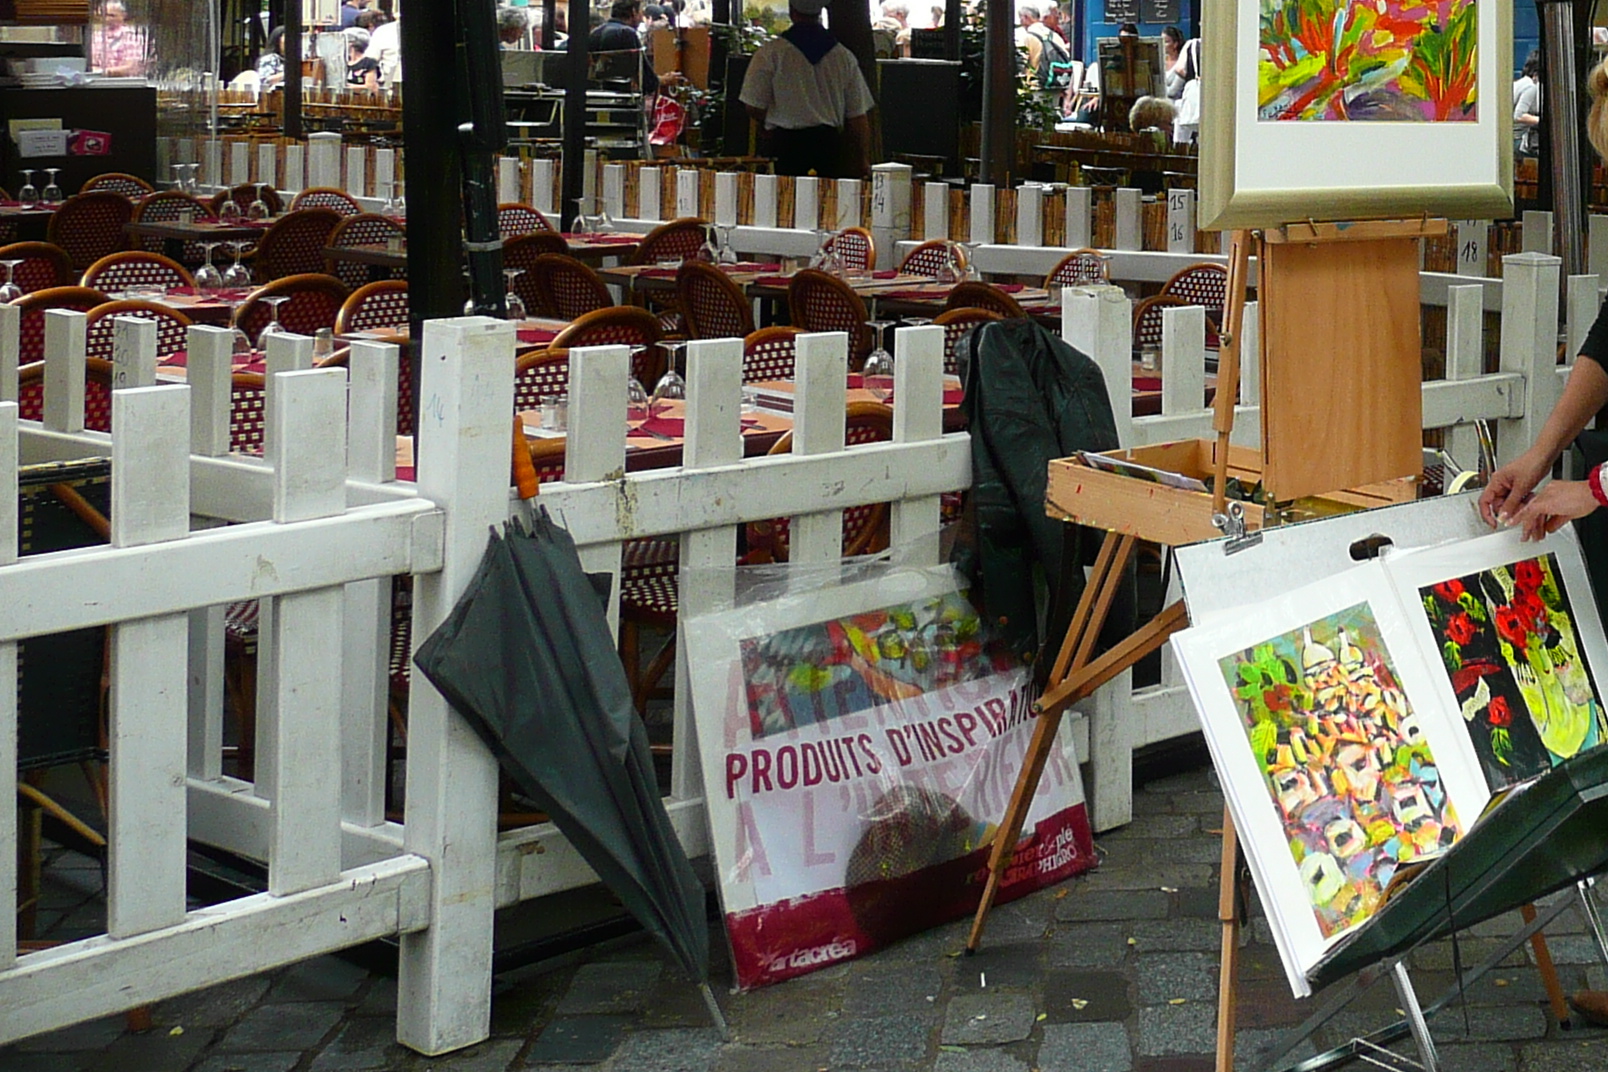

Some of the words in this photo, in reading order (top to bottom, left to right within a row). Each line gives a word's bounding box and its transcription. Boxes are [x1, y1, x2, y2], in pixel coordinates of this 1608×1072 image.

[1170, 194, 1187, 211] 15
[1170, 223, 1184, 242] 16
[1461, 240, 1478, 263] 18
[725, 732, 882, 799] PRODUITS
[768, 936, 857, 972] artacréa
